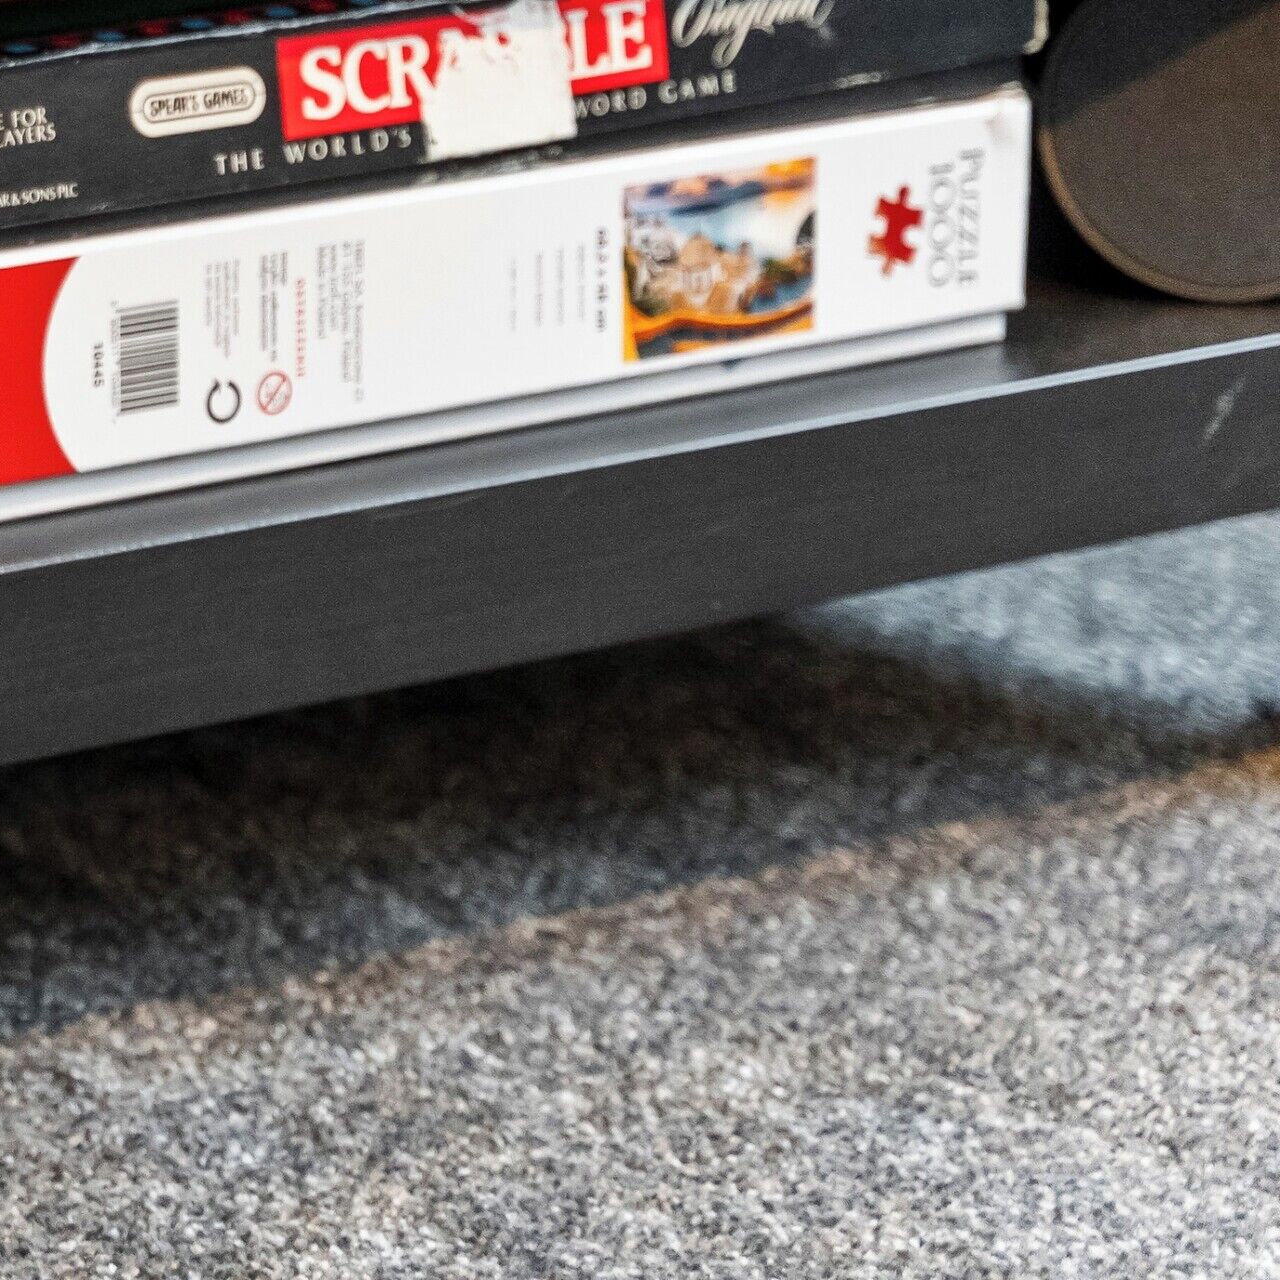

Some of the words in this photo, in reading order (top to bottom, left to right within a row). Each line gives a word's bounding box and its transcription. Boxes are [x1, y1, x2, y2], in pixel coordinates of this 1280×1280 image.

[203, 88, 249, 109] GAMES
[658, 69, 737, 104] GAME
[10, 105, 48, 128] FOR
[213, 147, 265, 176] THE
[283, 125, 412, 165] WORLD'S
[927, 161, 956, 288] 1000
